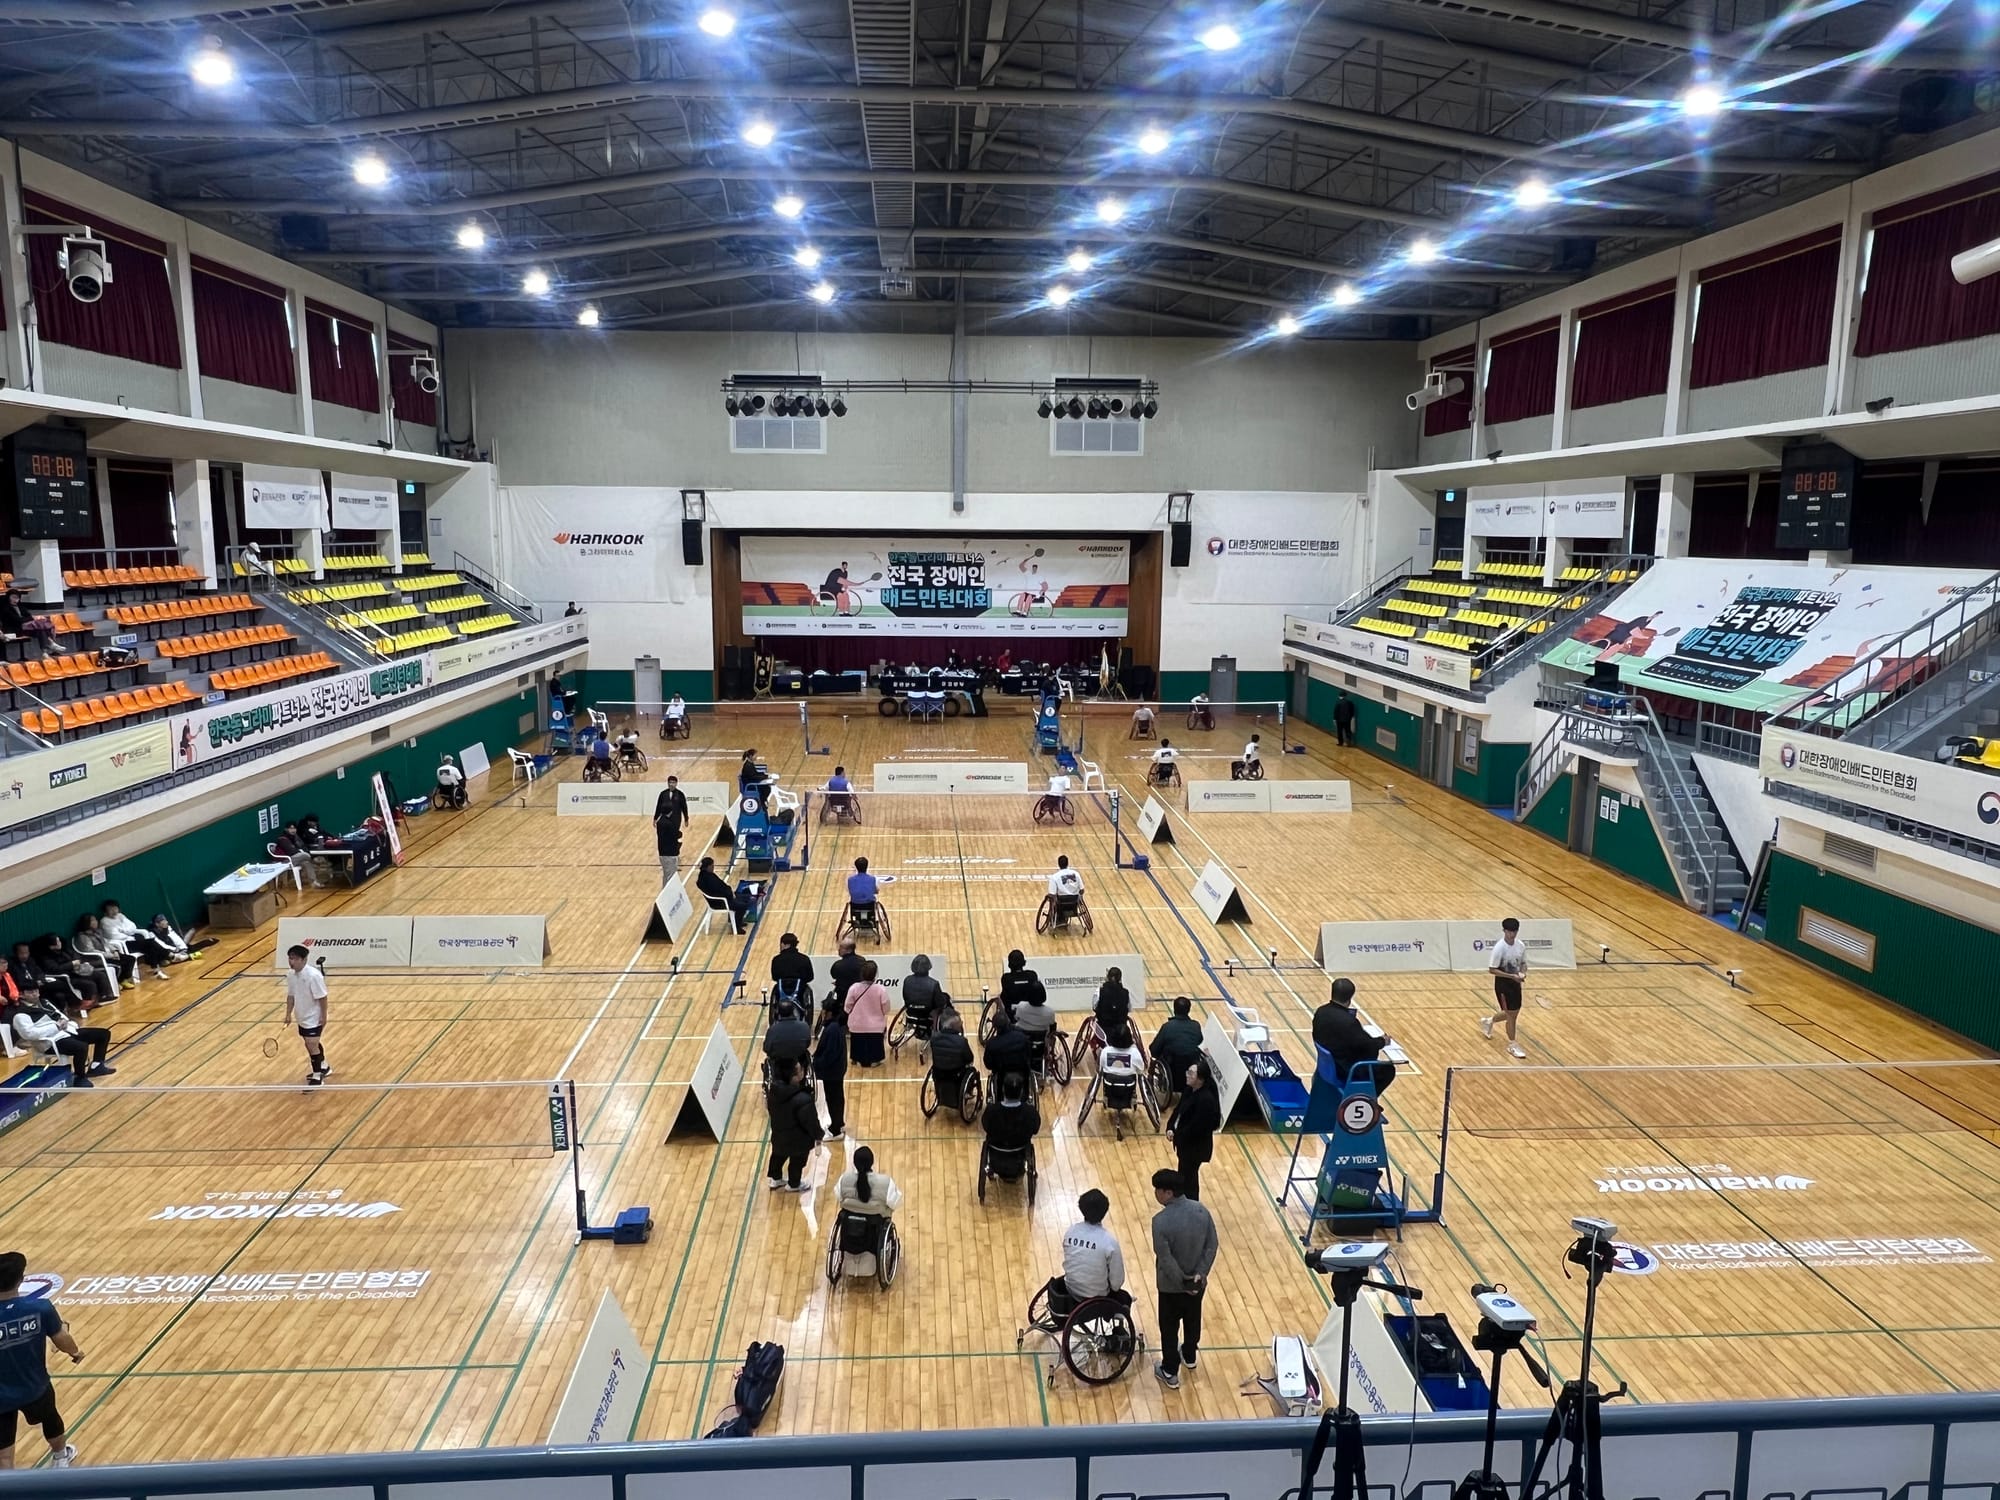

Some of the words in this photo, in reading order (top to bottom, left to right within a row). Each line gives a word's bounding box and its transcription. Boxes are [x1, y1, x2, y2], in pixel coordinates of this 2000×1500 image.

[888, 565, 926, 587] 전국
[930, 565, 986, 587] 장애인
[881, 588, 993, 609] 배드민턴대회
[1708, 604, 1760, 629] 전국
[1750, 607, 1829, 637] 장애인
[1681, 627, 1807, 666] 배드민턴대회
[336, 673, 370, 709] 장애인
[64, 766, 86, 783] YONEX
[1799, 749, 1918, 792] 대한장애인배드민턴협회
[552, 1084, 560, 1094] 4
[1353, 1105, 1364, 1119] 5
[553, 1118, 567, 1148] YONEX
[1352, 1155, 1378, 1165] YONEX
[1349, 1185, 1370, 1197] YONEX
[1068, 1237, 1097, 1250] KOREA
[1651, 1238, 1982, 1261] 대한장애인배드민턴협회
[64, 1270, 432, 1294] 대한장애인배드민턴협회
[53, 1296, 101, 1306] Korea
[104, 1295, 192, 1305] Badminton
[198, 1292, 290, 1304] Association
[292, 1292, 317, 1301] for
[318, 1291, 344, 1300] the
[346, 1289, 418, 1300] Disabled
[22, 1320, 37, 1331] 46
